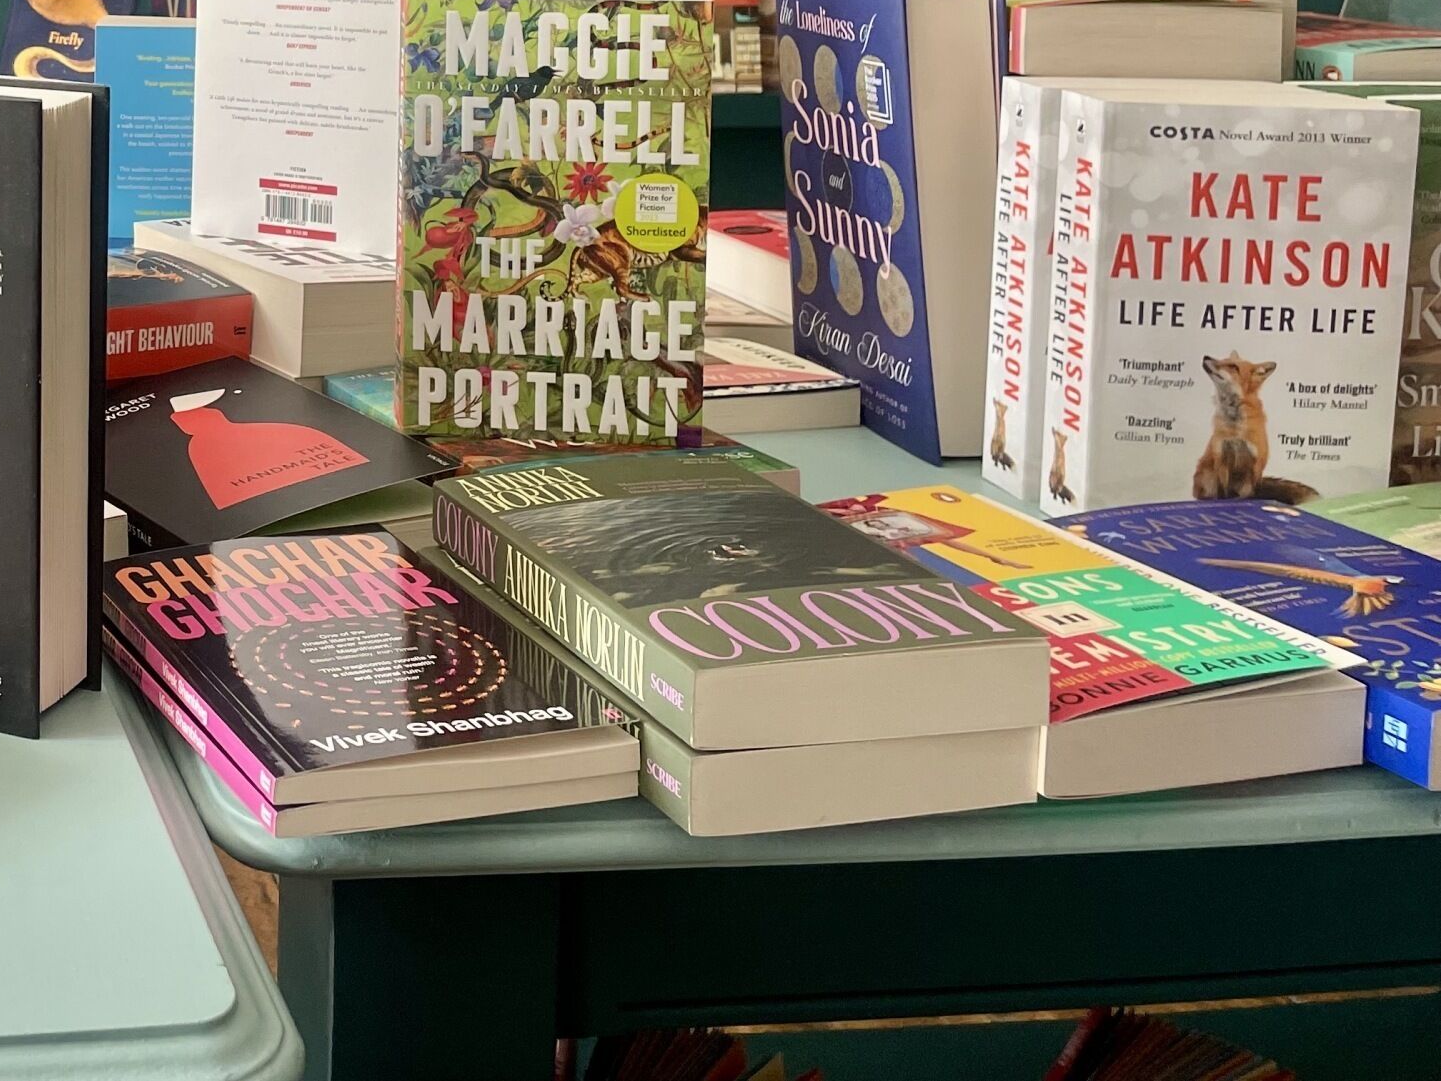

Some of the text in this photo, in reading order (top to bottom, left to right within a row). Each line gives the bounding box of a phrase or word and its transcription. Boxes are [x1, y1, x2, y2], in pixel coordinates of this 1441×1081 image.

[47, 30, 85, 49] Firefly
[445, 10, 671, 81] MAGGIE
[795, 8, 878, 54] Loneliness of
[593, 85, 703, 98] BESTSELLER
[414, 94, 700, 166] O'FARRELL
[790, 77, 881, 169] Sonia
[1149, 125, 1373, 145] COSTA Novel Award 2013 Winner
[639, 193, 658, 202] Prize
[639, 203, 667, 212] Fiction
[1189, 171, 1324, 223] KATE
[625, 224, 687, 239] Shortlisted
[793, 170, 894, 280] Sunny
[476, 236, 545, 281] THE
[994, 231, 1009, 301] AFTER
[1003, 140, 1032, 402] KATE ATKINSON
[1110, 233, 1391, 289] ATKINSON
[1049, 192, 1073, 386] LIFE AFTER LIFE
[1061, 156, 1094, 433] KATE ATKINSON
[137, 321, 215, 353] BEHAVIOUR
[412, 291, 697, 363] MARRIAGE
[1119, 299, 1377, 336] LIFE AFTER LIFE
[798, 302, 914, 388] Kiran Desai
[1118, 358, 1185, 372] 'Triumphant'
[1107, 373, 1195, 390] Daily Telegraph
[1298, 382, 1317, 394] box
[417, 366, 688, 438] PORTRAIT
[1292, 398, 1369, 411] Hilary Mantel
[1114, 431, 1185, 444] Gillian Flynn
[1125, 415, 1177, 431] 'Dazzling'
[230, 448, 346, 488] HANDMAID'S
[296, 441, 335, 457] THE
[312, 454, 358, 472] TALE
[1286, 450, 1341, 462] The Times
[458, 466, 591, 499] ANNIKA
[471, 479, 603, 514] NORLIN
[1118, 509, 1260, 535] SARAH
[1124, 519, 1337, 557] WINMAN
[114, 533, 416, 606] GHACHAR
[145, 567, 460, 641] GHOCHAR
[435, 493, 647, 703] COLONY ANNIKA NORLIN
[648, 582, 1016, 661] COLONY
[1051, 611, 1090, 629] In
[650, 672, 685, 712] SCRIBE
[1050, 647, 1311, 712] BONNIE GARMUS
[310, 705, 575, 754] Vivek Shanbhag
[646, 758, 683, 799] SCRIBE
